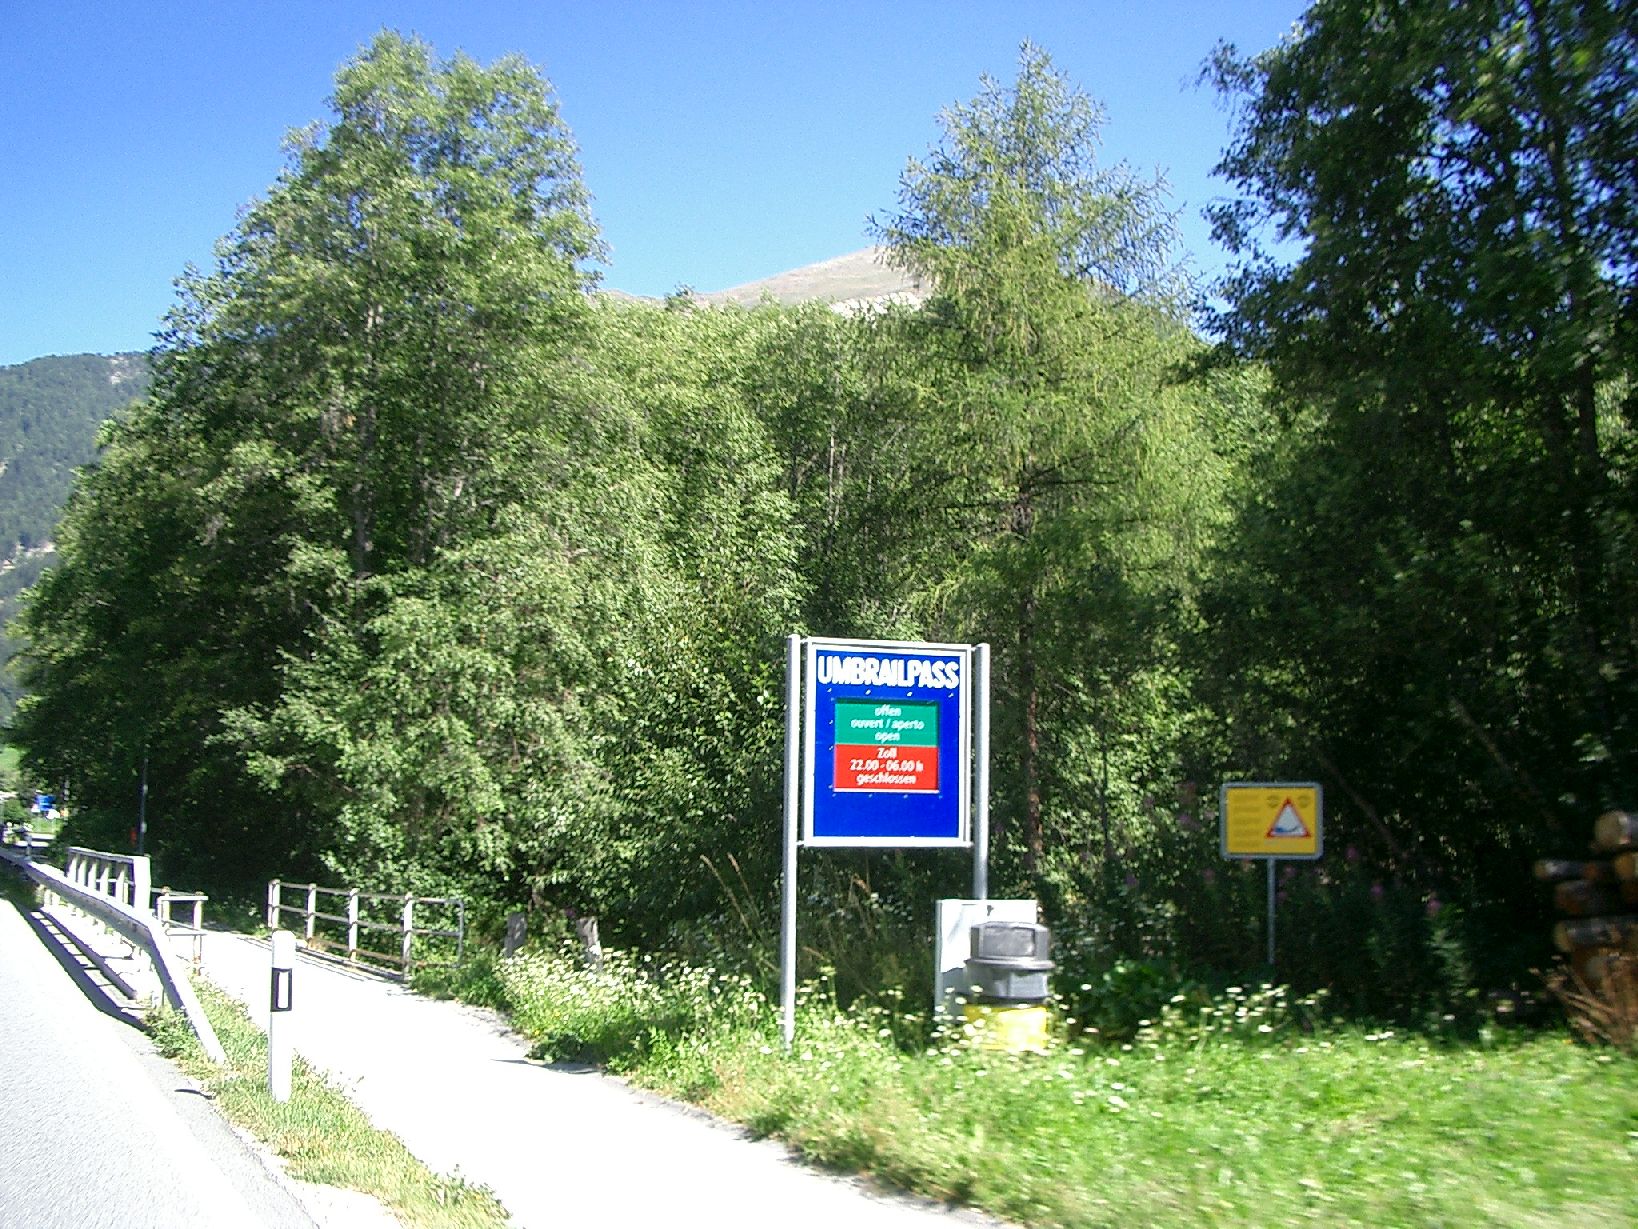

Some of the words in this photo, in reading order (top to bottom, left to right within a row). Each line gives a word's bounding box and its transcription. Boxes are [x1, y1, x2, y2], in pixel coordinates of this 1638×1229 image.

[818, 655, 960, 689] UMBRAILPASS
[874, 704, 901, 717] offen
[850, 719, 883, 729] ouvert
[891, 720, 925, 731] aperto
[874, 732, 900, 743] open
[877, 747, 897, 758] Zoll
[850, 759, 879, 771] 22.00
[886, 760, 914, 772] 06.00
[856, 772, 917, 785] geschlossen
